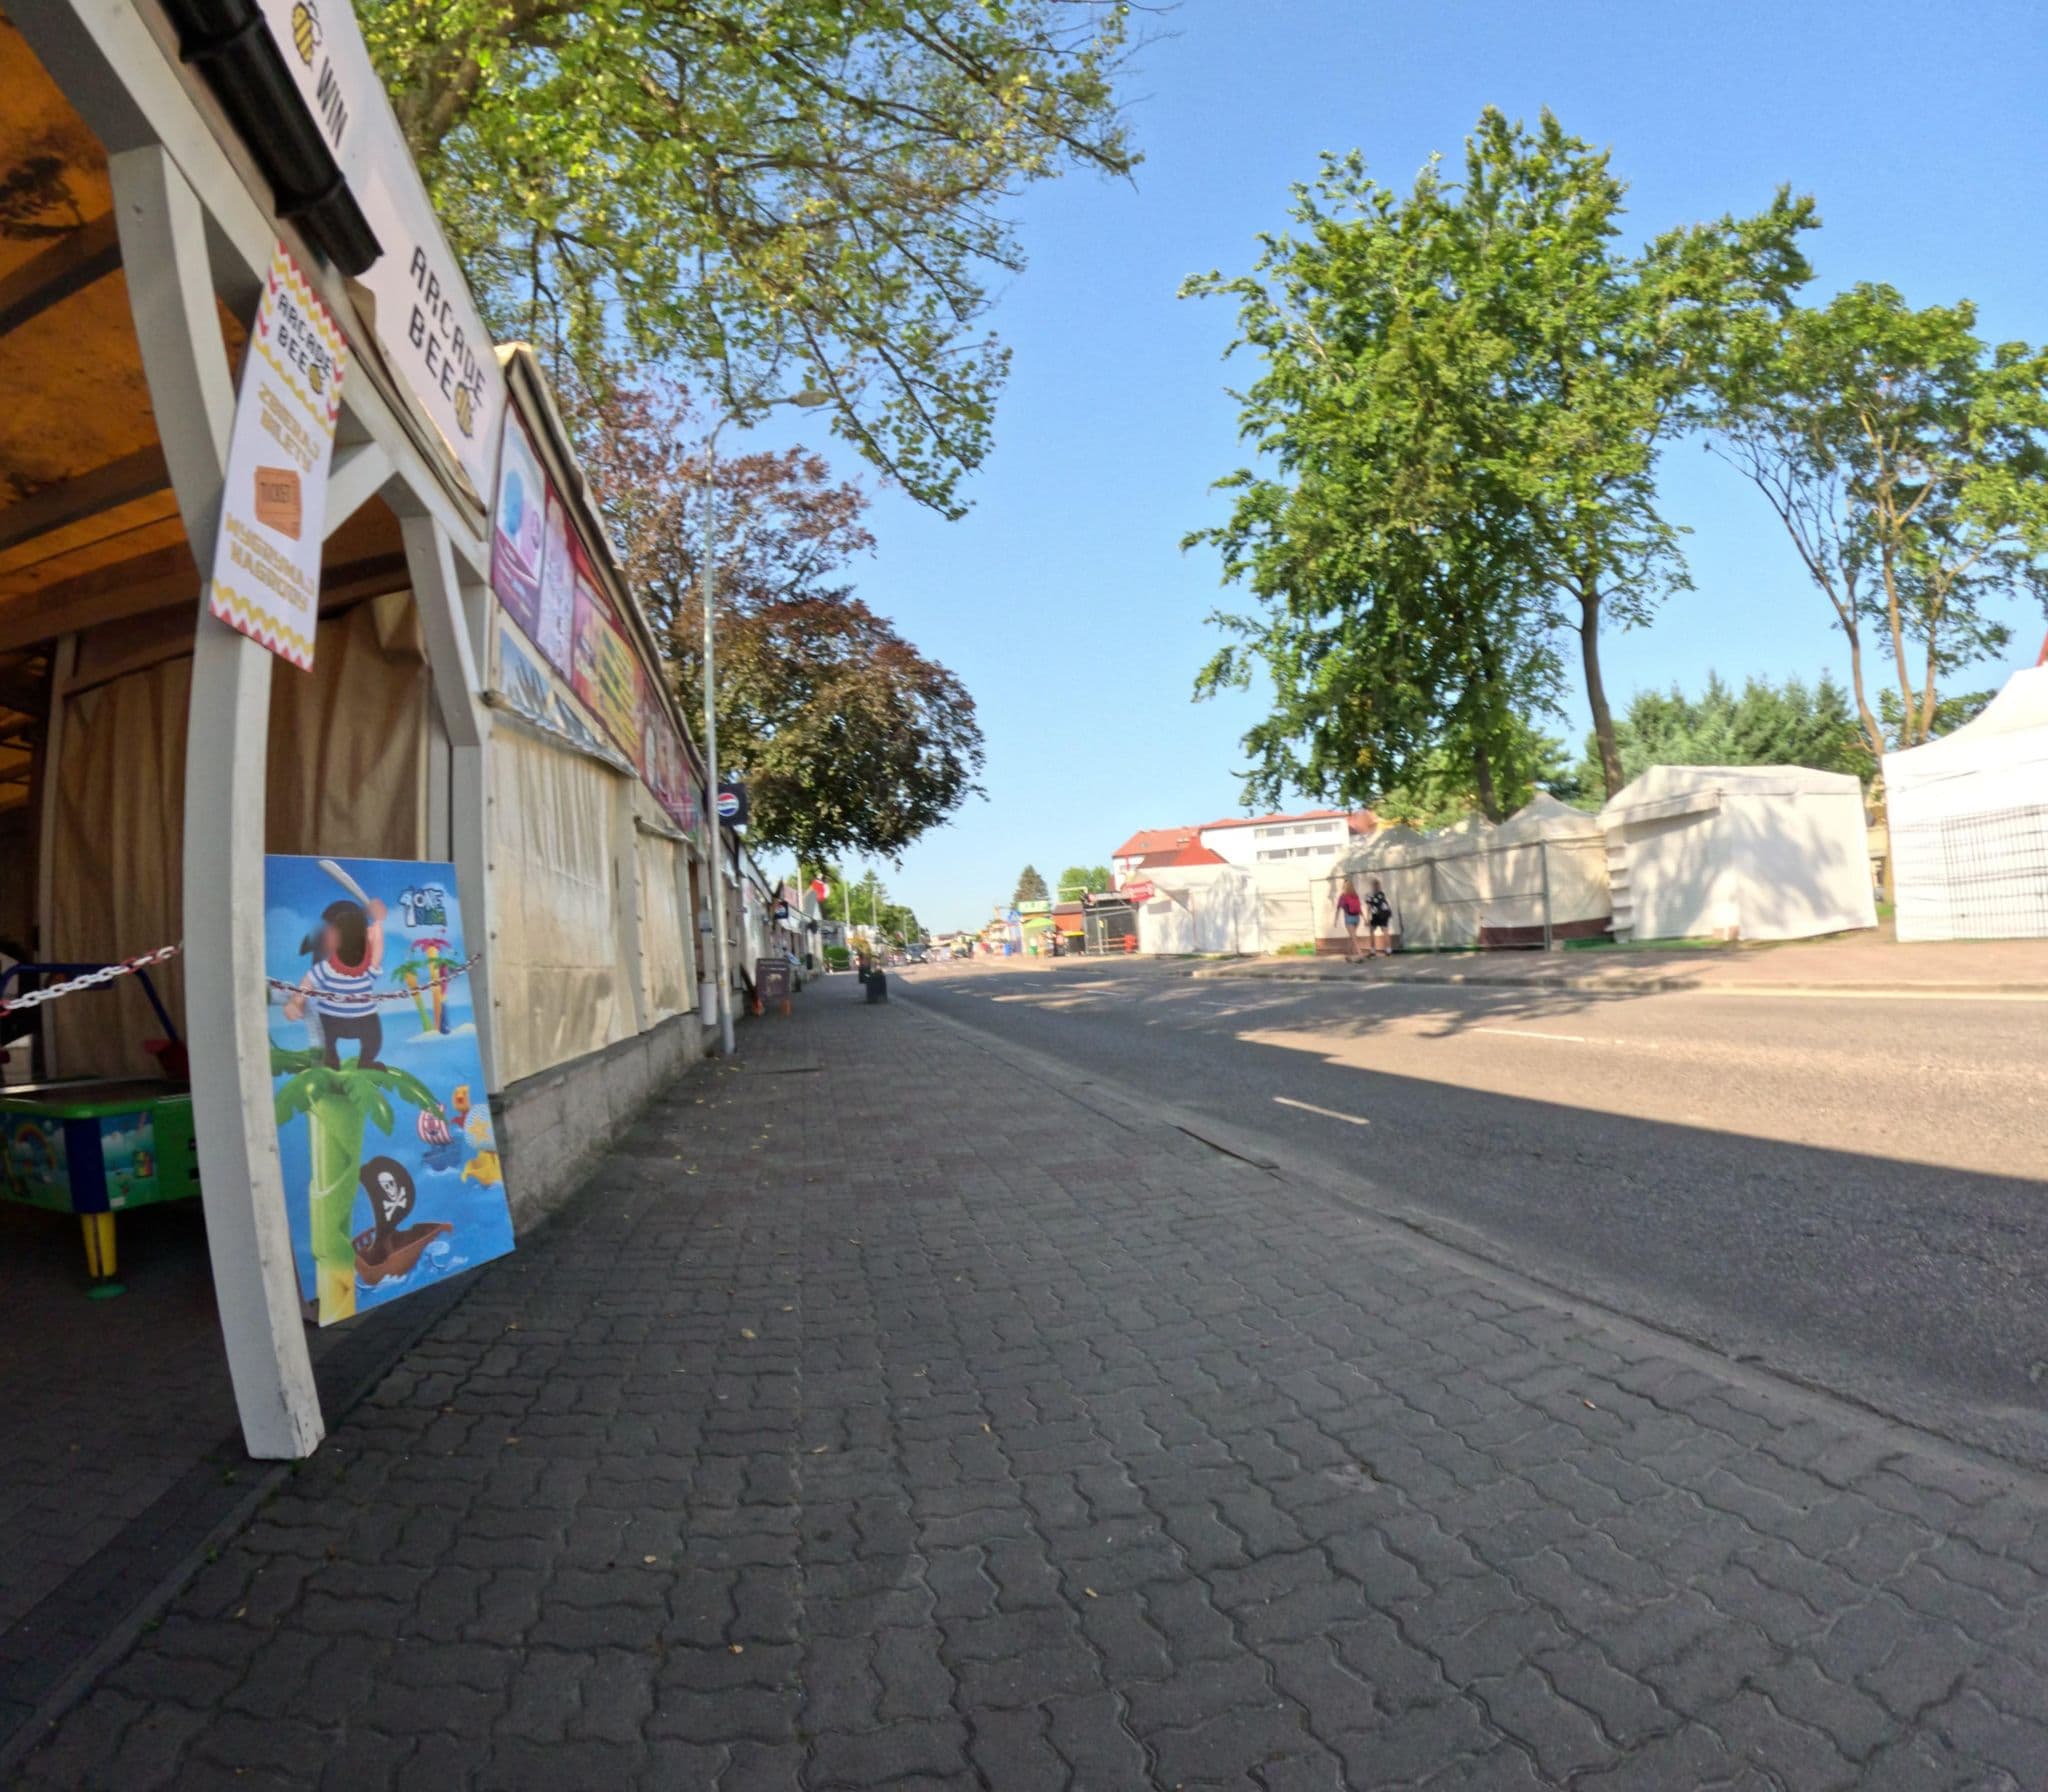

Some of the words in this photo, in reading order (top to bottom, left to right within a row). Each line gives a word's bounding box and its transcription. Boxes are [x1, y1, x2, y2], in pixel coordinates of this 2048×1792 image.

[315, 57, 349, 151] WIN
[276, 292, 334, 379] ARCADE
[277, 325, 308, 376] BEE
[408, 245, 487, 408] ARCADE
[408, 303, 453, 402] BEE
